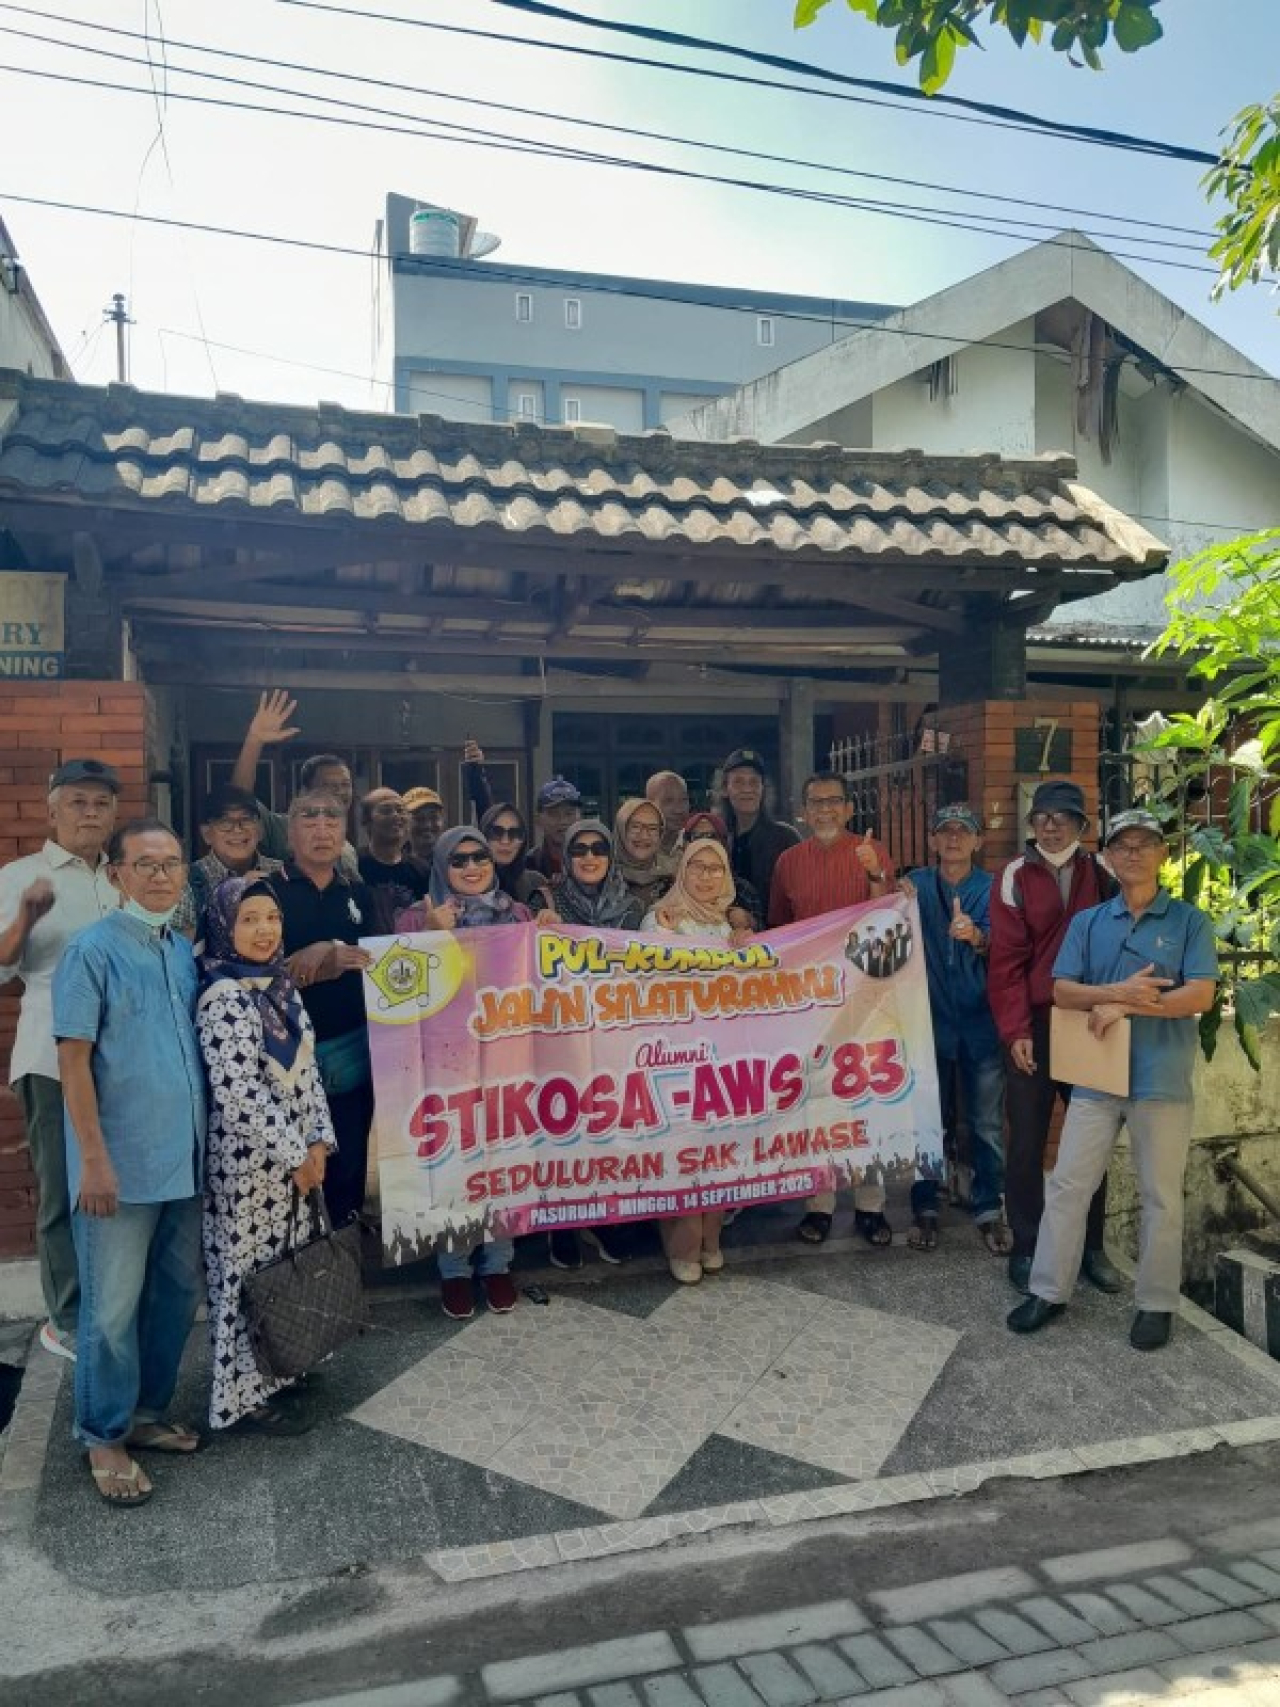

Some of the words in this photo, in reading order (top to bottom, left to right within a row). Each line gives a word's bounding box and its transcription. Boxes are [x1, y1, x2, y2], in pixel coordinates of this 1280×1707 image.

[1034, 718, 1059, 771] 7
[465, 1151, 665, 1203] SEDULURAN
[675, 1141, 740, 1175] SAK
[753, 1119, 869, 1164] LAWASE
[529, 1202, 608, 1226] PASURUAN
[618, 1196, 679, 1216] MINGGU,
[701, 1179, 777, 1207] SEPTEMBER
